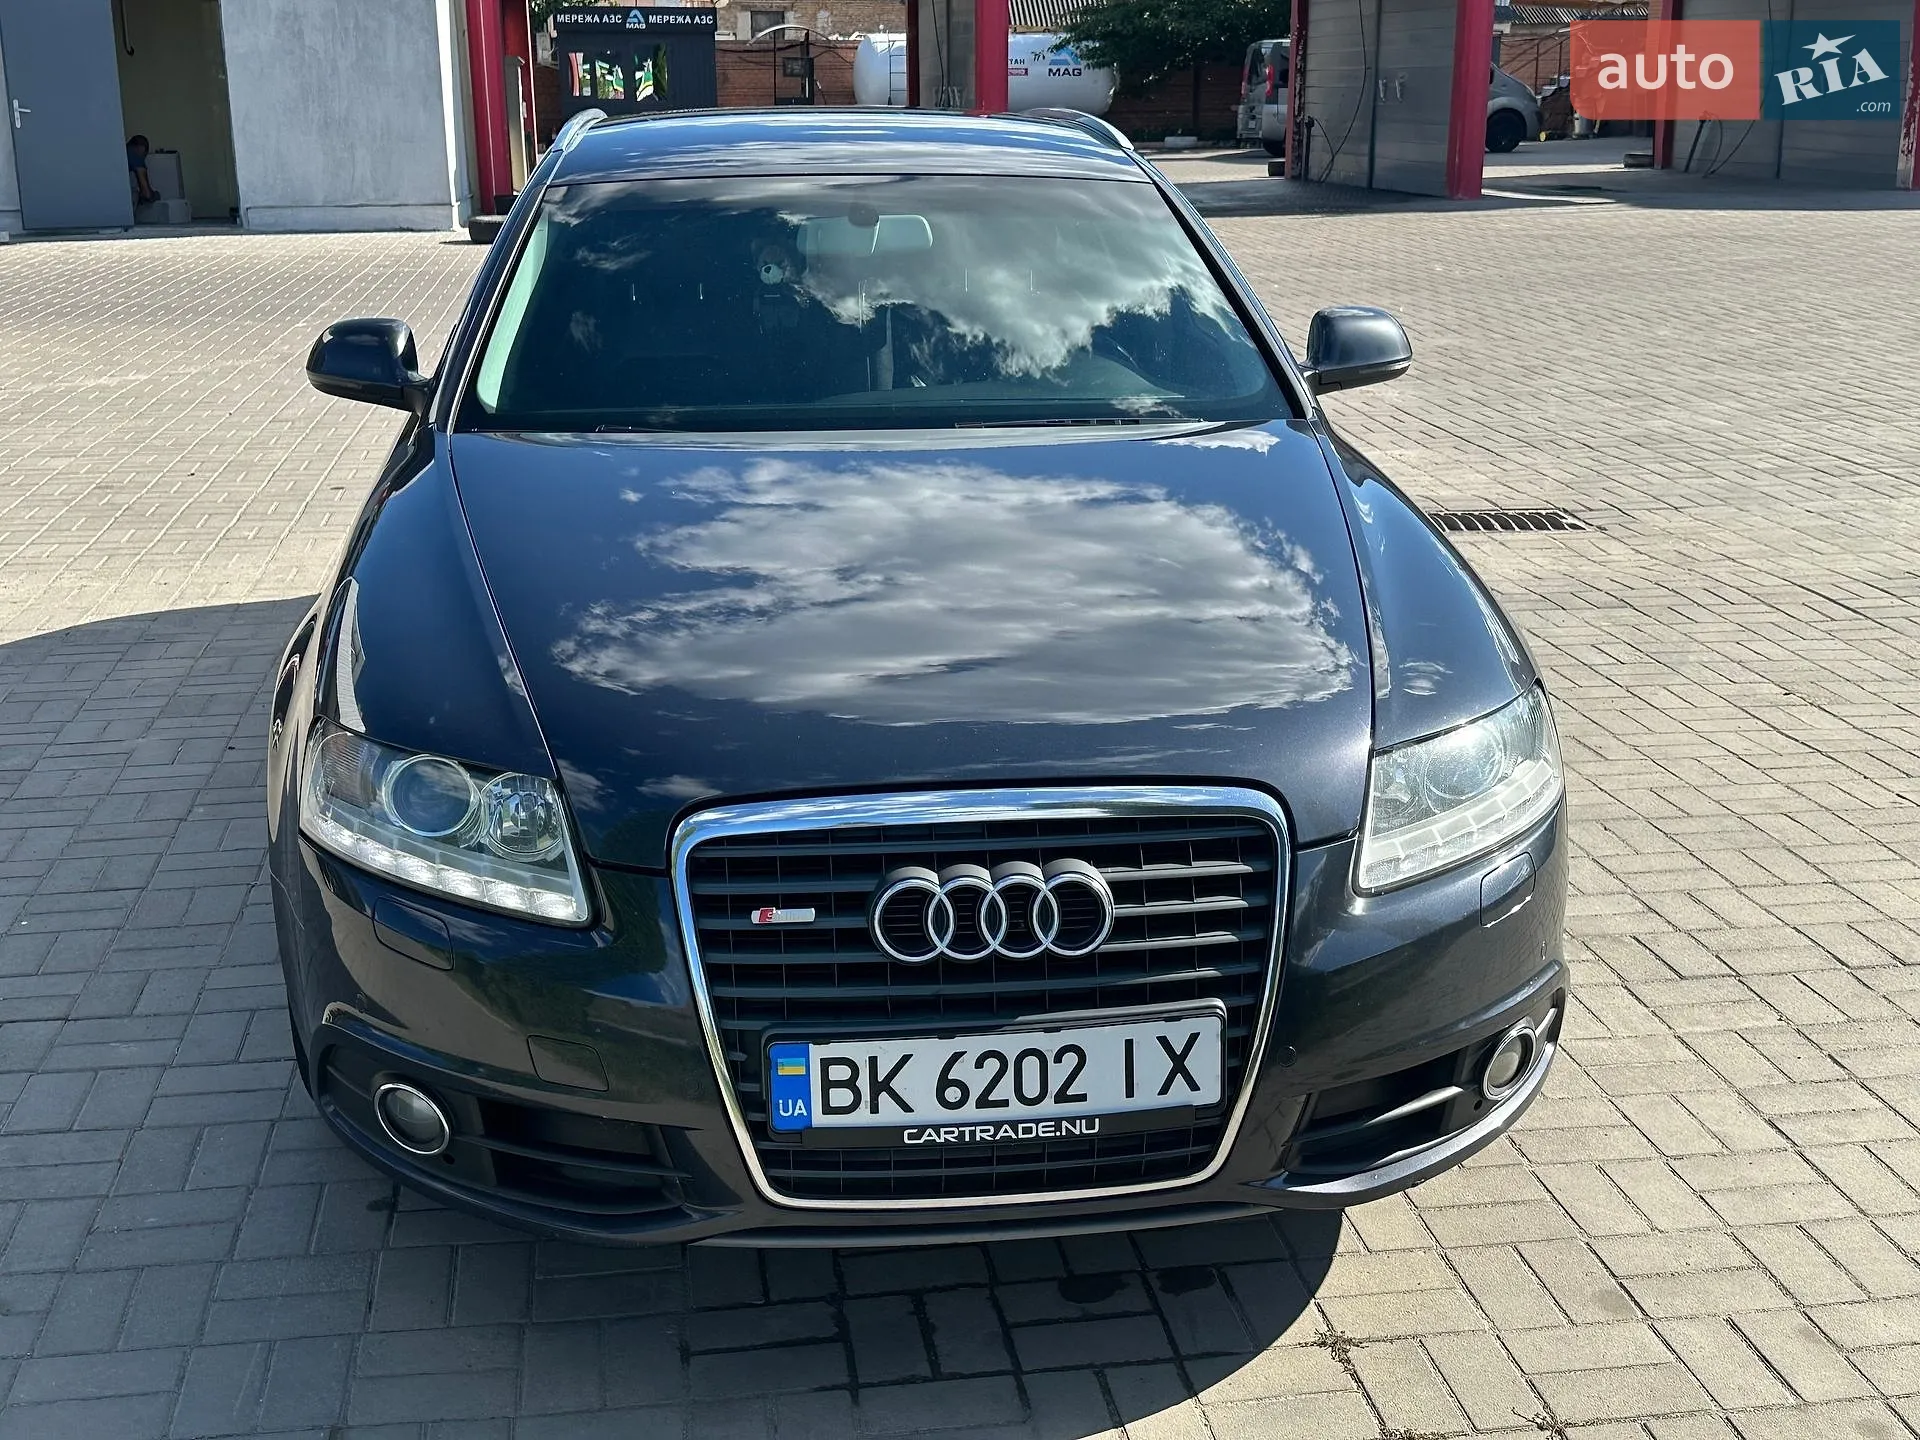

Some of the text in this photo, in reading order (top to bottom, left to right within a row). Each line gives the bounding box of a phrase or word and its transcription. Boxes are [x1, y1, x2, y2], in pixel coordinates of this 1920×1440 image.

[556, 14, 623, 24] МЕРЕЖА АЗС
[648, 14, 714, 25] МЕРЕЖА АЗС
[1048, 67, 1082, 77] MAG
[819, 1053, 914, 1115] BK
[935, 1043, 1088, 1111] 6202
[778, 1098, 807, 1117] UA
[903, 1117, 1100, 1144] CARTRADE.NU
